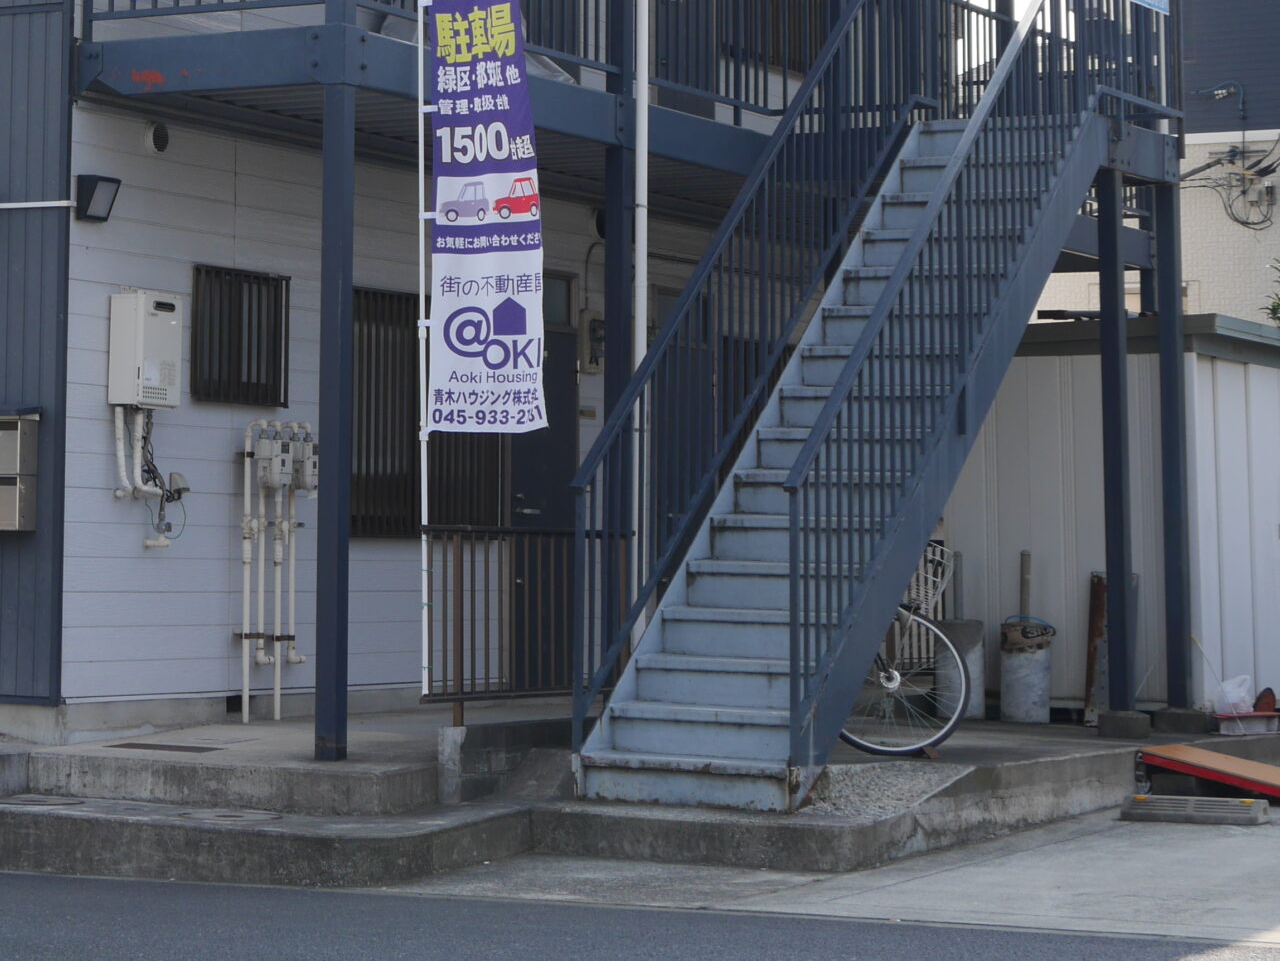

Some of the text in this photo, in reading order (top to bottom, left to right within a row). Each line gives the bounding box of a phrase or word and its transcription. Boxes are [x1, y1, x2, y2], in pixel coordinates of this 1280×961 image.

[435, 2, 516, 64] 駐車場
[448, 370, 537, 384] Aoki Housing
